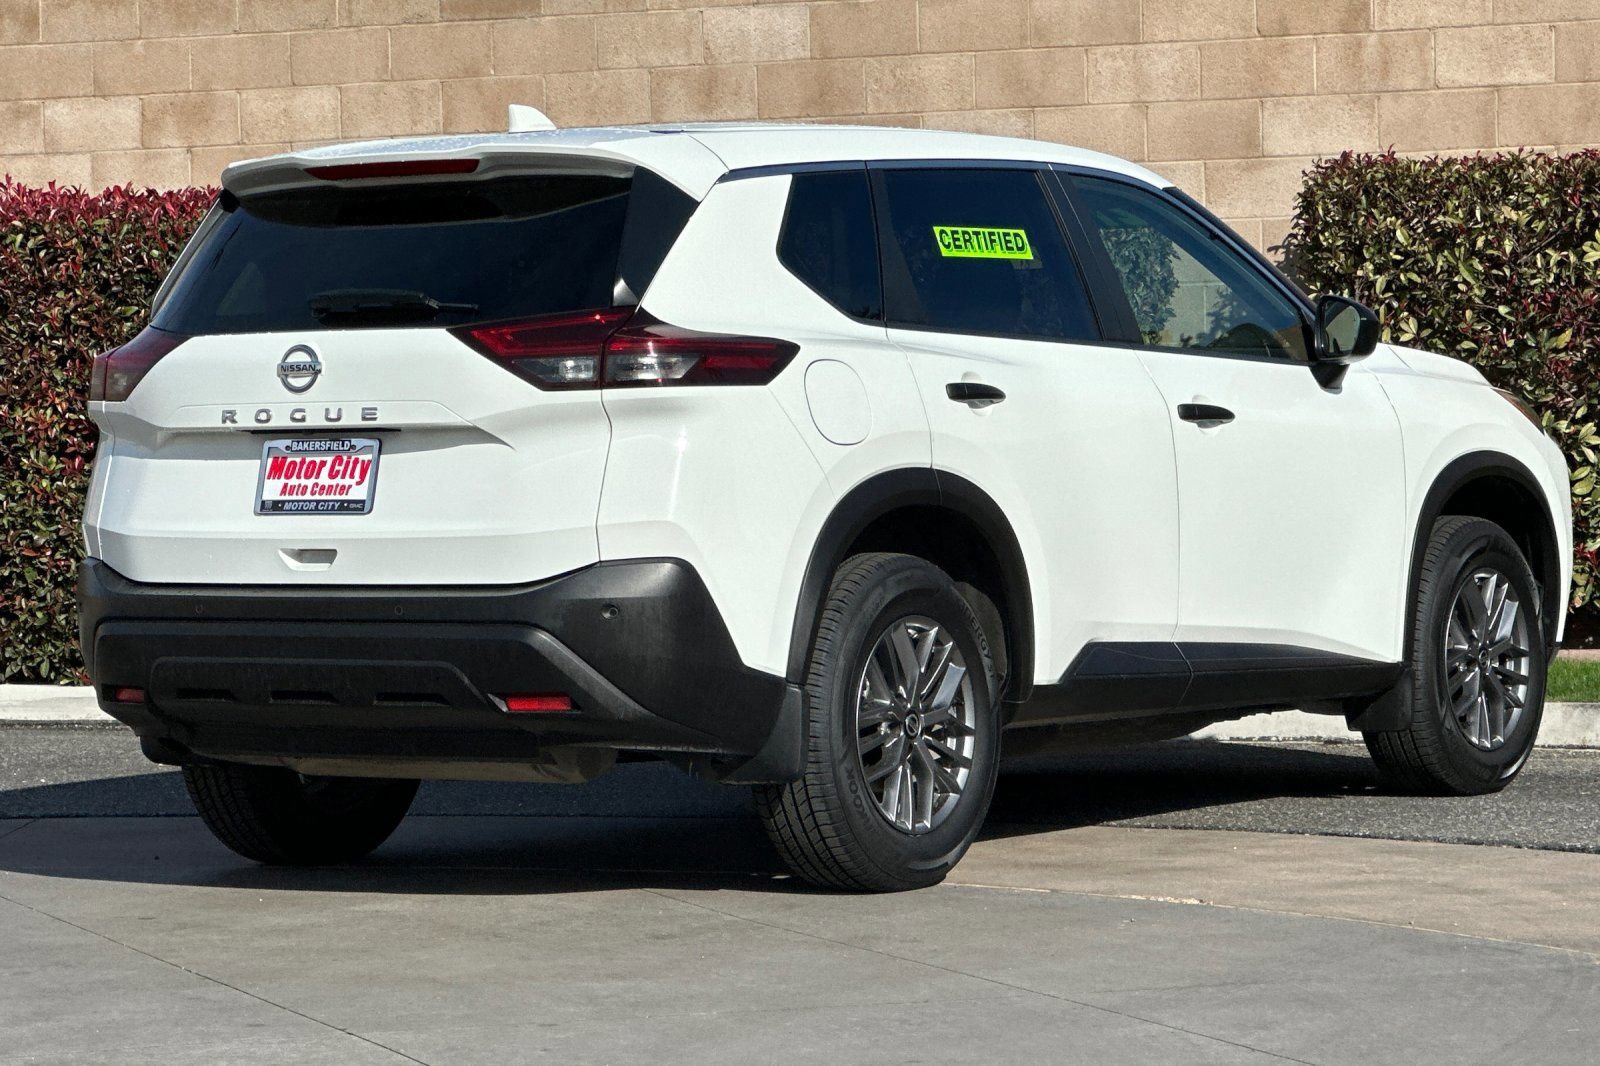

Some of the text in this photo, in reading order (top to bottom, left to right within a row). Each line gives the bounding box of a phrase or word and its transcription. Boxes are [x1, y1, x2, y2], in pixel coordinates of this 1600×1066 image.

[939, 229, 1027, 253] CERTIFIED
[281, 364, 316, 372] NISSAN
[221, 407, 378, 424] ROGUE
[291, 441, 351, 451] BAKERSFIELD
[266, 454, 372, 486] Motor City
[279, 482, 353, 497] Auto Center
[283, 501, 317, 511] MOTOR
[317, 501, 341, 510] CITY
